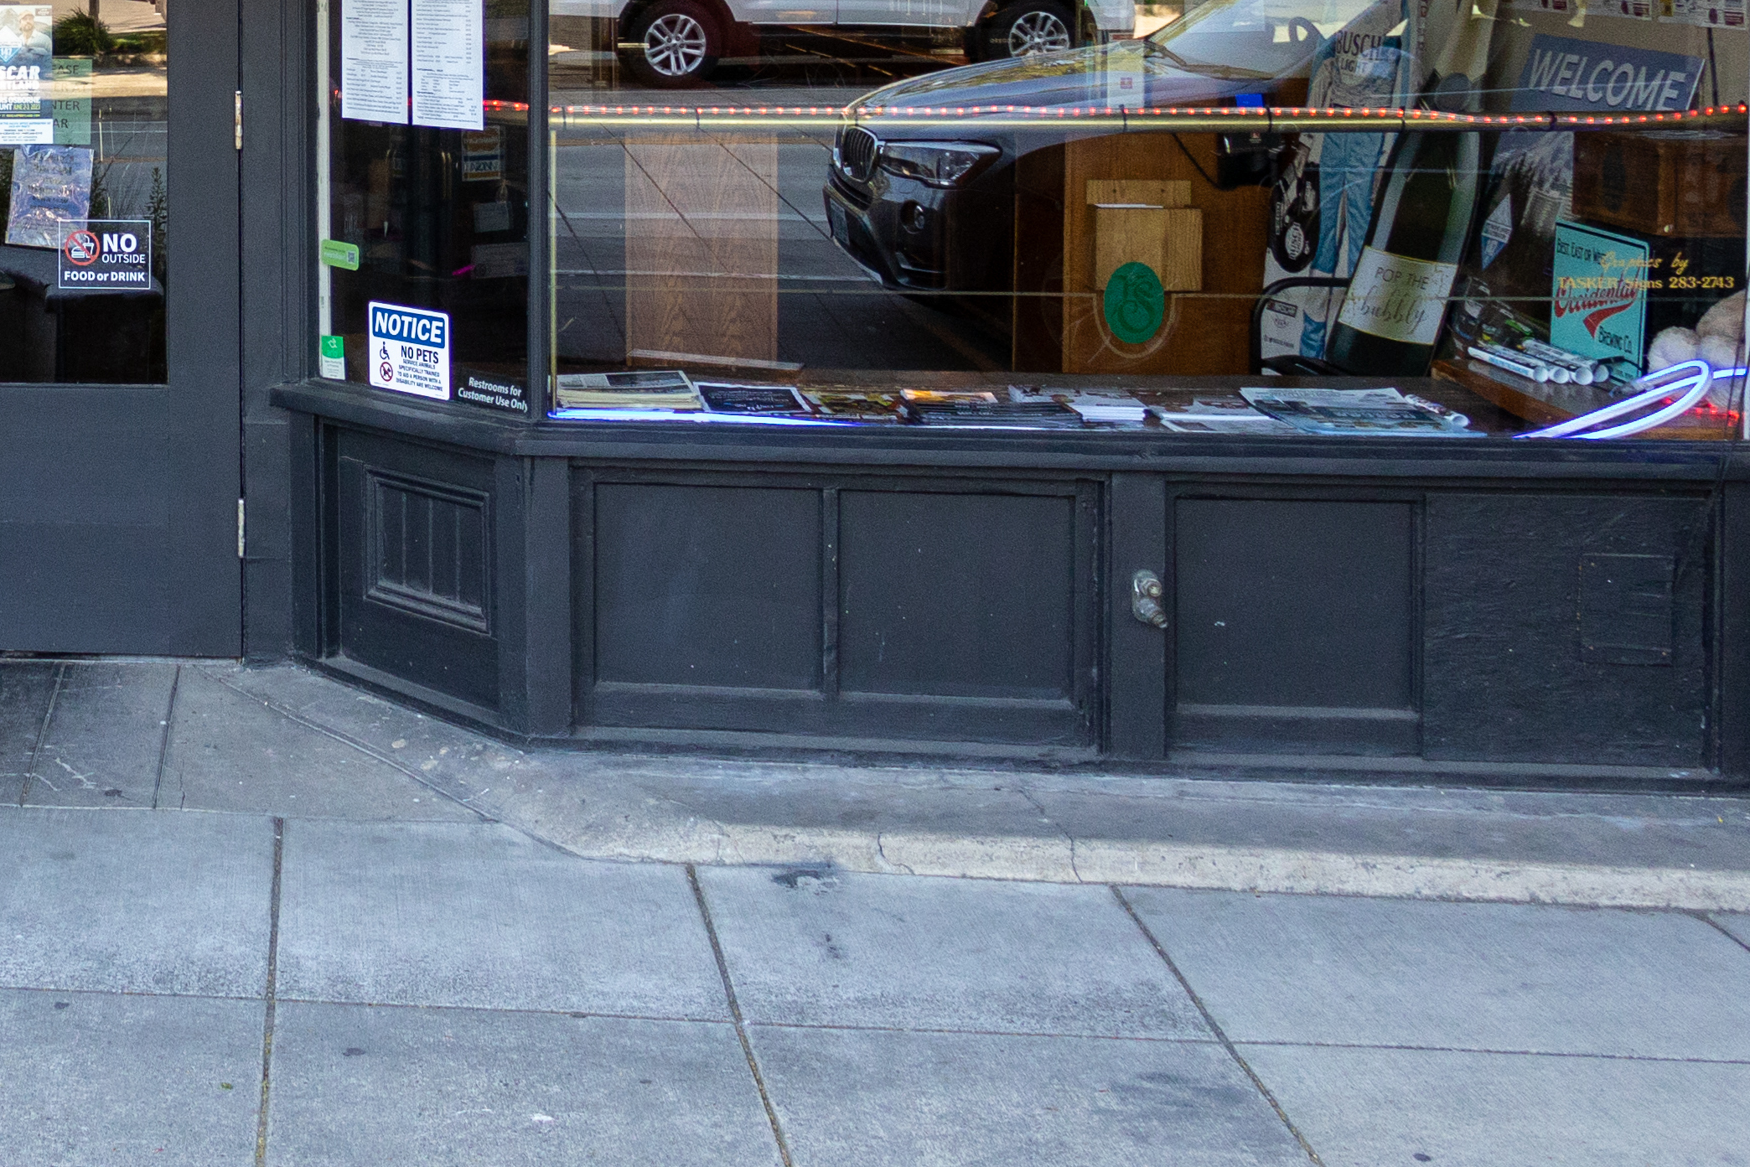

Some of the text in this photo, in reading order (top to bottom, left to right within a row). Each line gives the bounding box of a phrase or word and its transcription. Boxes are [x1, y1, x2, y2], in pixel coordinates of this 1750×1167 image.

[1336, 31, 1382, 59] BUSCH
[1529, 48, 1688, 110] WELCOME
[102, 233, 137, 252] NO
[102, 254, 146, 264] OUTSIDE
[1671, 251, 1689, 275] by
[64, 271, 145, 282] FOOD or DRINK
[1375, 267, 1429, 290] POP THE
[1557, 276, 1735, 291] TASKER Signs 283-2743
[1361, 285, 1426, 334] bubbly
[375, 311, 444, 343] NOTICE
[401, 345, 439, 364] NO PETS
[468, 377, 522, 397] Restrooms for
[458, 388, 528, 413] Customer Use Only
